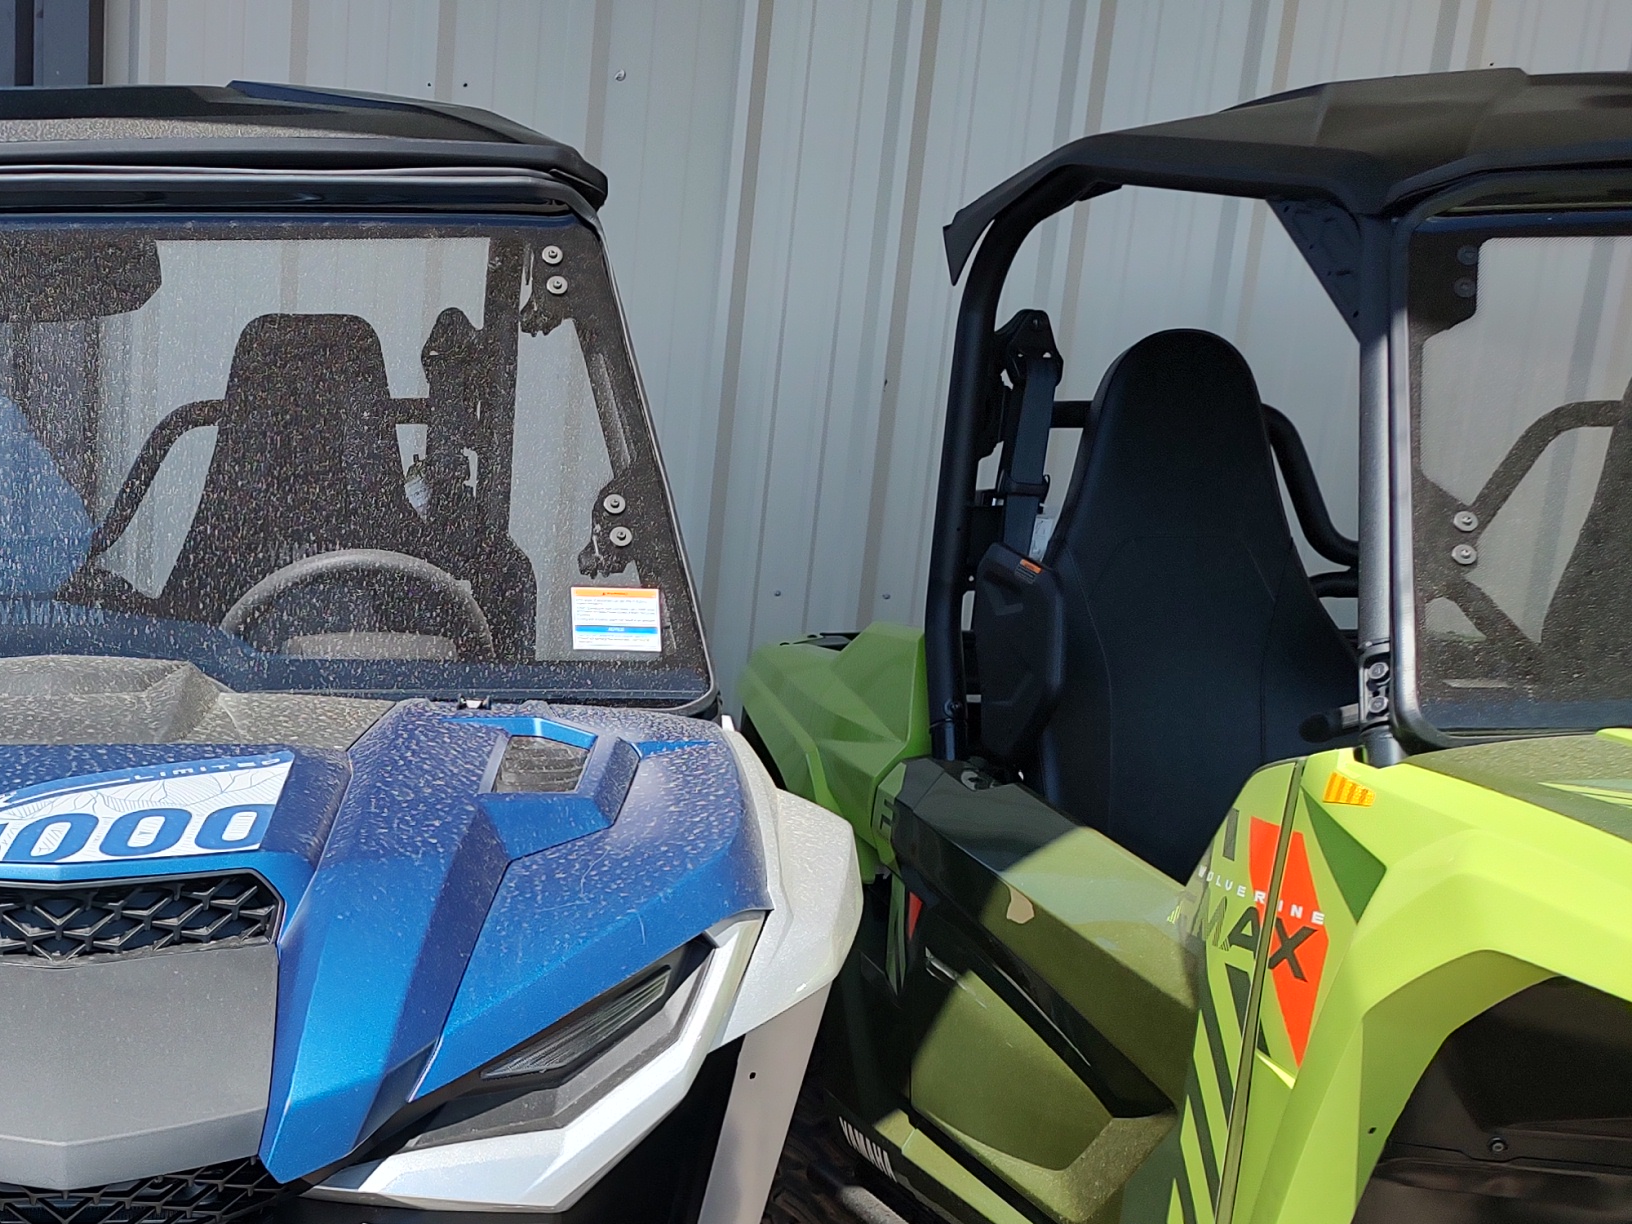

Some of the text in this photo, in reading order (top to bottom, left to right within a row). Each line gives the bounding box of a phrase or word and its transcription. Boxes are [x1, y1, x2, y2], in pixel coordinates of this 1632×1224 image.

[134, 757, 280, 780] LIMITED
[1198, 865, 1325, 925] WOLVERINE
[838, 1115, 898, 1183] YAMAHA
